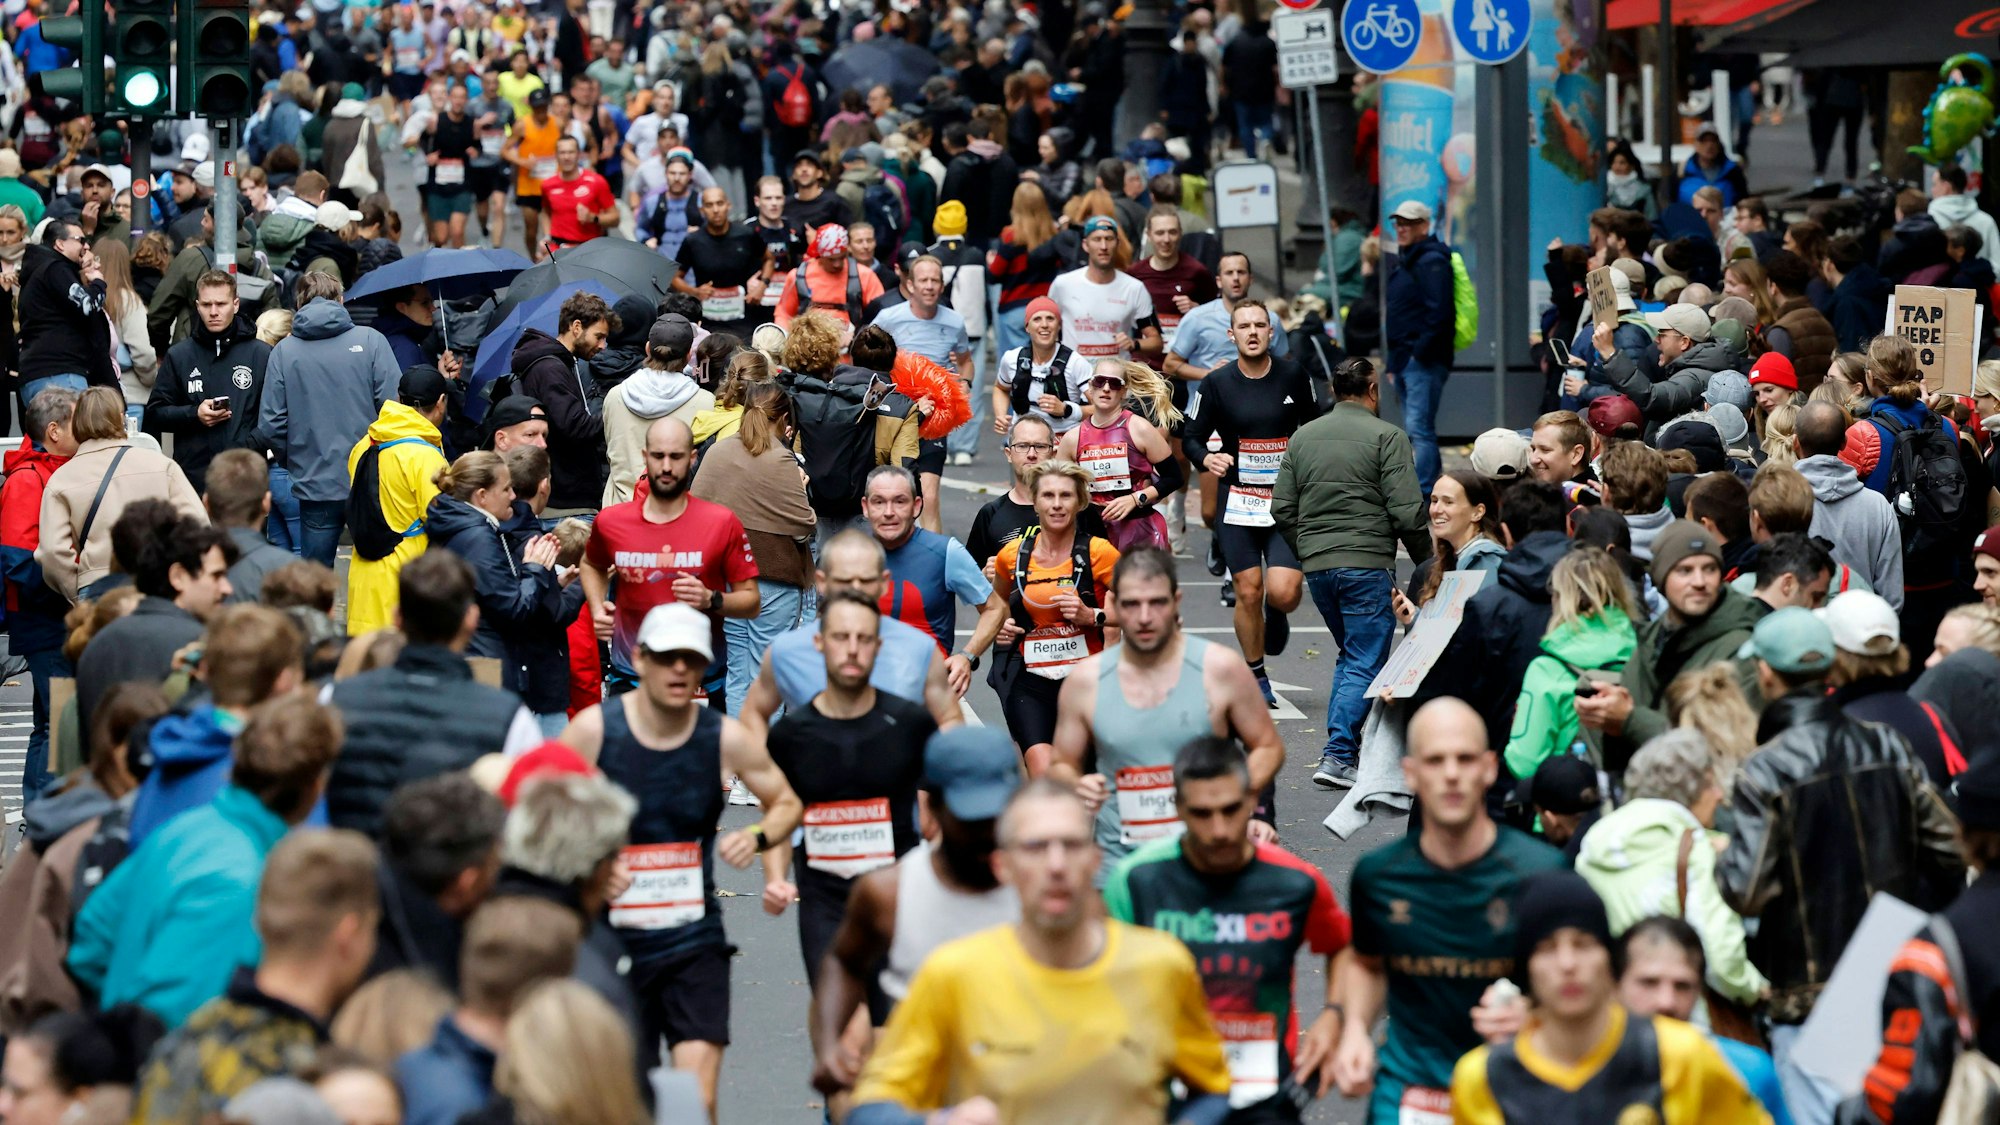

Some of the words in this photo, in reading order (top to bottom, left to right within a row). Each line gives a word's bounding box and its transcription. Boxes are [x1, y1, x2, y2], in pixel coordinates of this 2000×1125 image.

[1899, 305, 1943, 324] TAP
[188, 379, 203, 394] MR
[1251, 441, 1287, 451] GENERALI
[1248, 454, 1280, 464] T993/4
[1092, 461, 1111, 471] Lea
[1243, 486, 1272, 497] GENERA
[615, 549, 702, 568] IRONMAN
[1033, 641, 1077, 653] Renate
